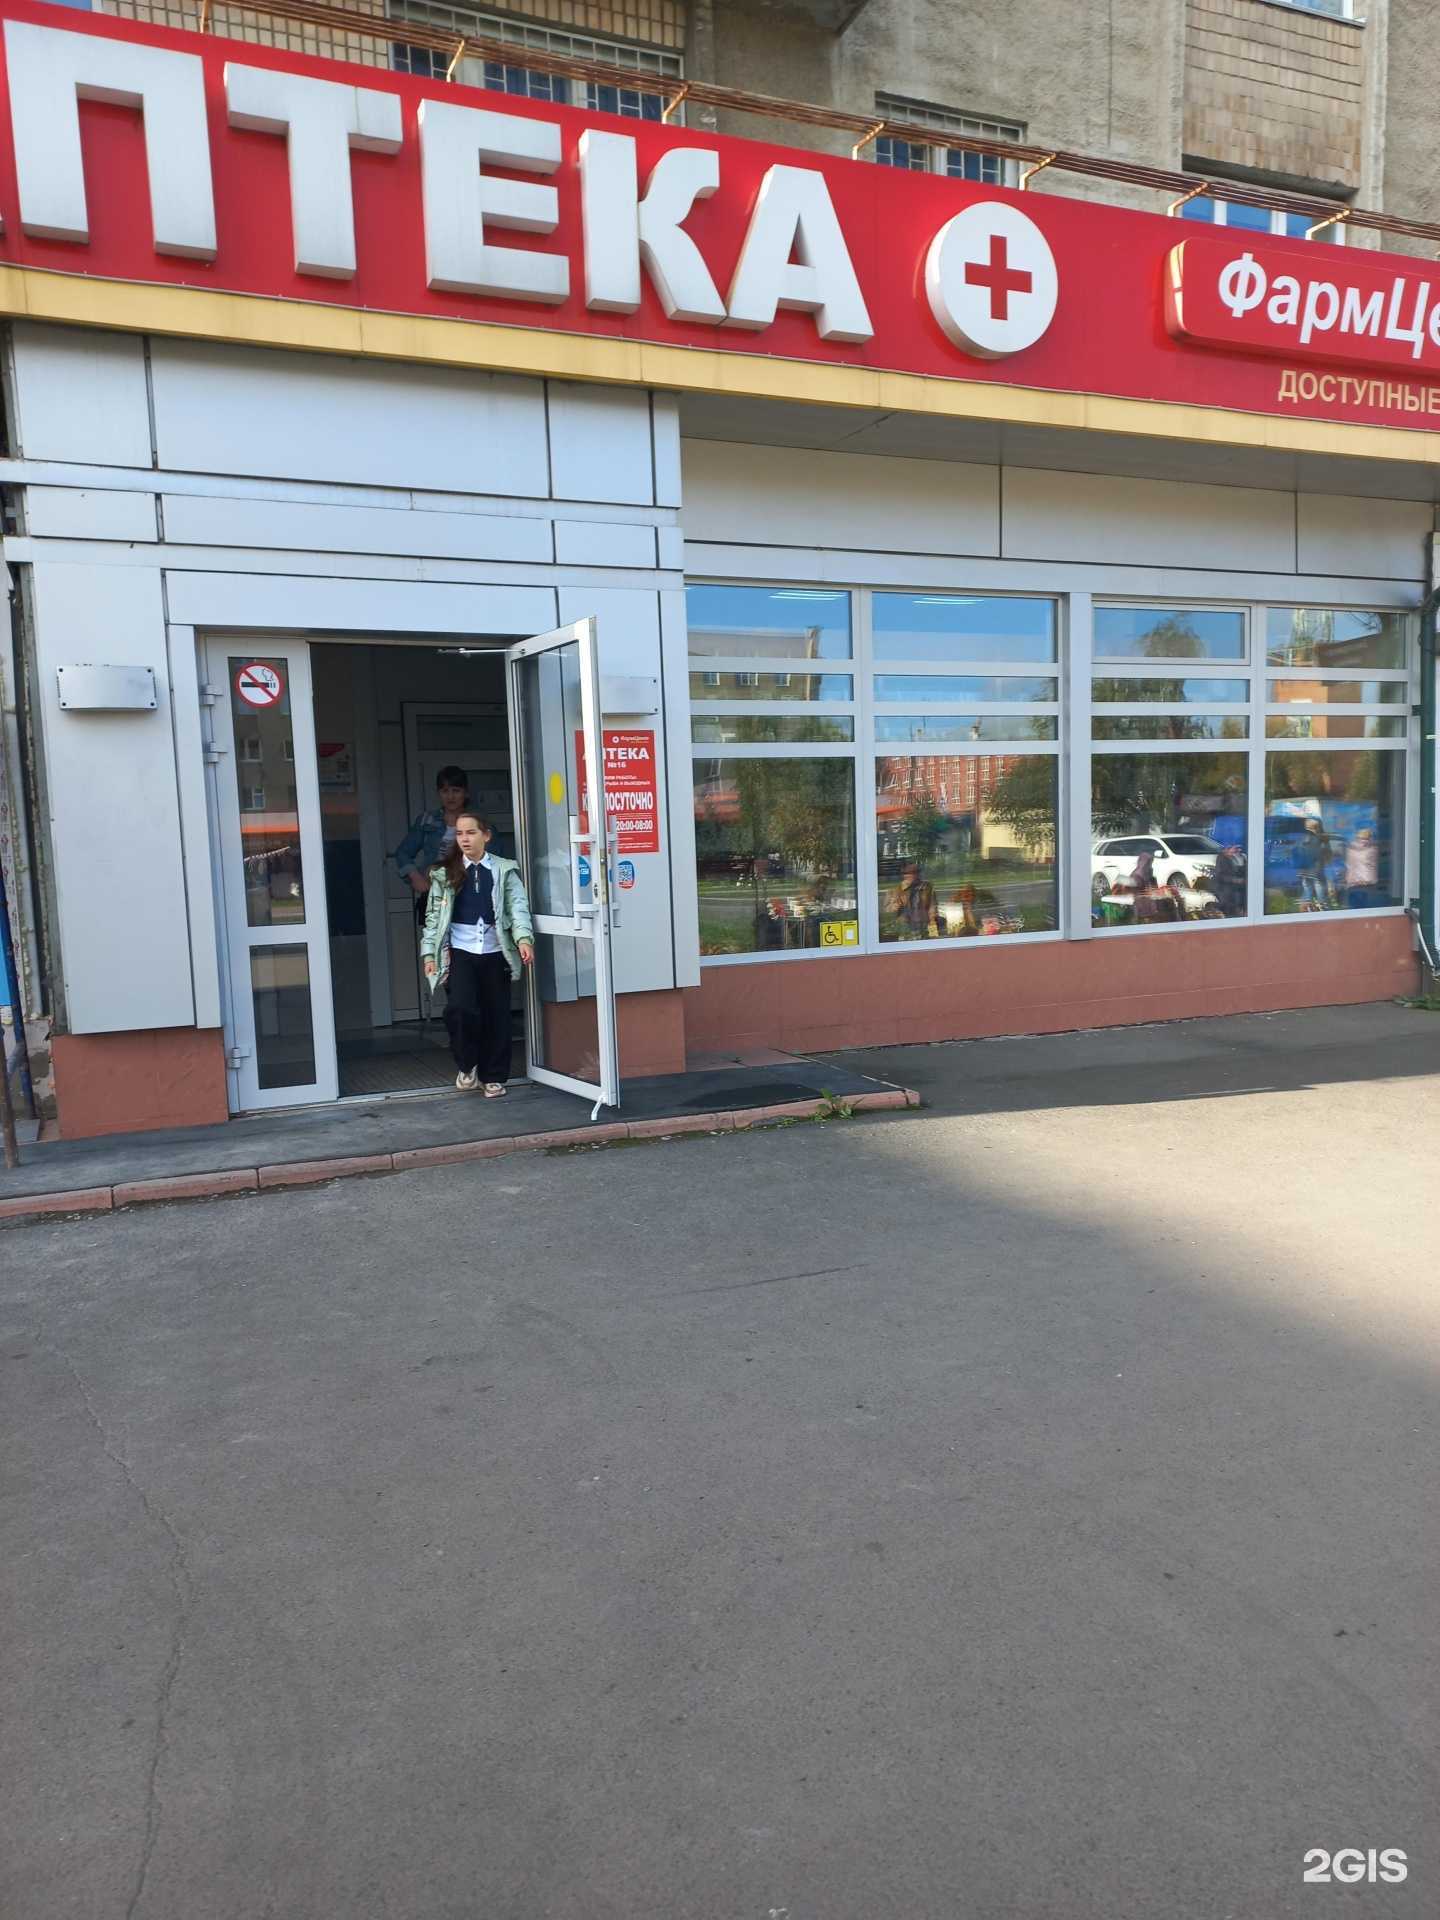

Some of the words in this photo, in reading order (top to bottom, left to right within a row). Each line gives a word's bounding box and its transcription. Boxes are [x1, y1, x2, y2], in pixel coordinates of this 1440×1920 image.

[0, 19, 874, 343] ПТЕКА
[1278, 370, 1440, 414] ДОСТУПНЫЕ
[582, 747, 650, 760] ТЕКА
